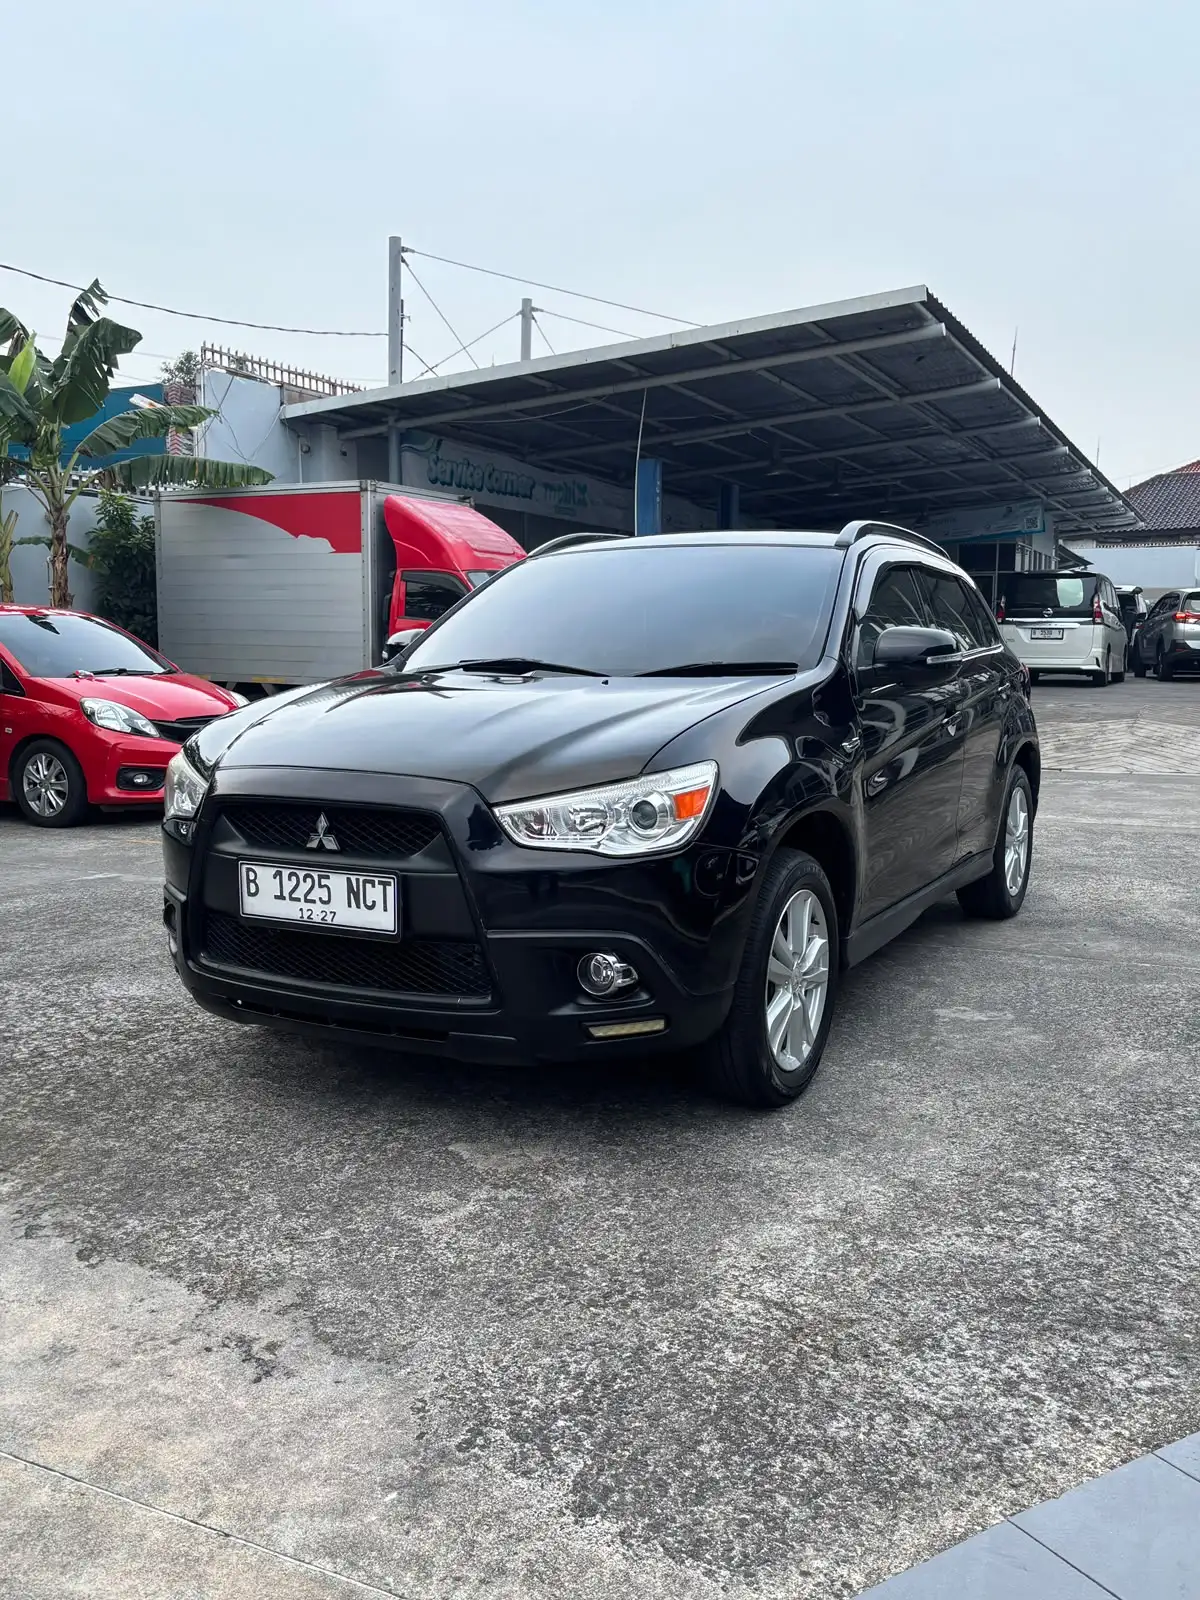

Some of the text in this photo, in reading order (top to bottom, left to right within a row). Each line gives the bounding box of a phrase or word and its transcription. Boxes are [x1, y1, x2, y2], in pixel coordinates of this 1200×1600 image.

[427, 453, 485, 492] Service
[484, 463, 535, 499] Corner
[245, 867, 392, 912] B 1225 NCT
